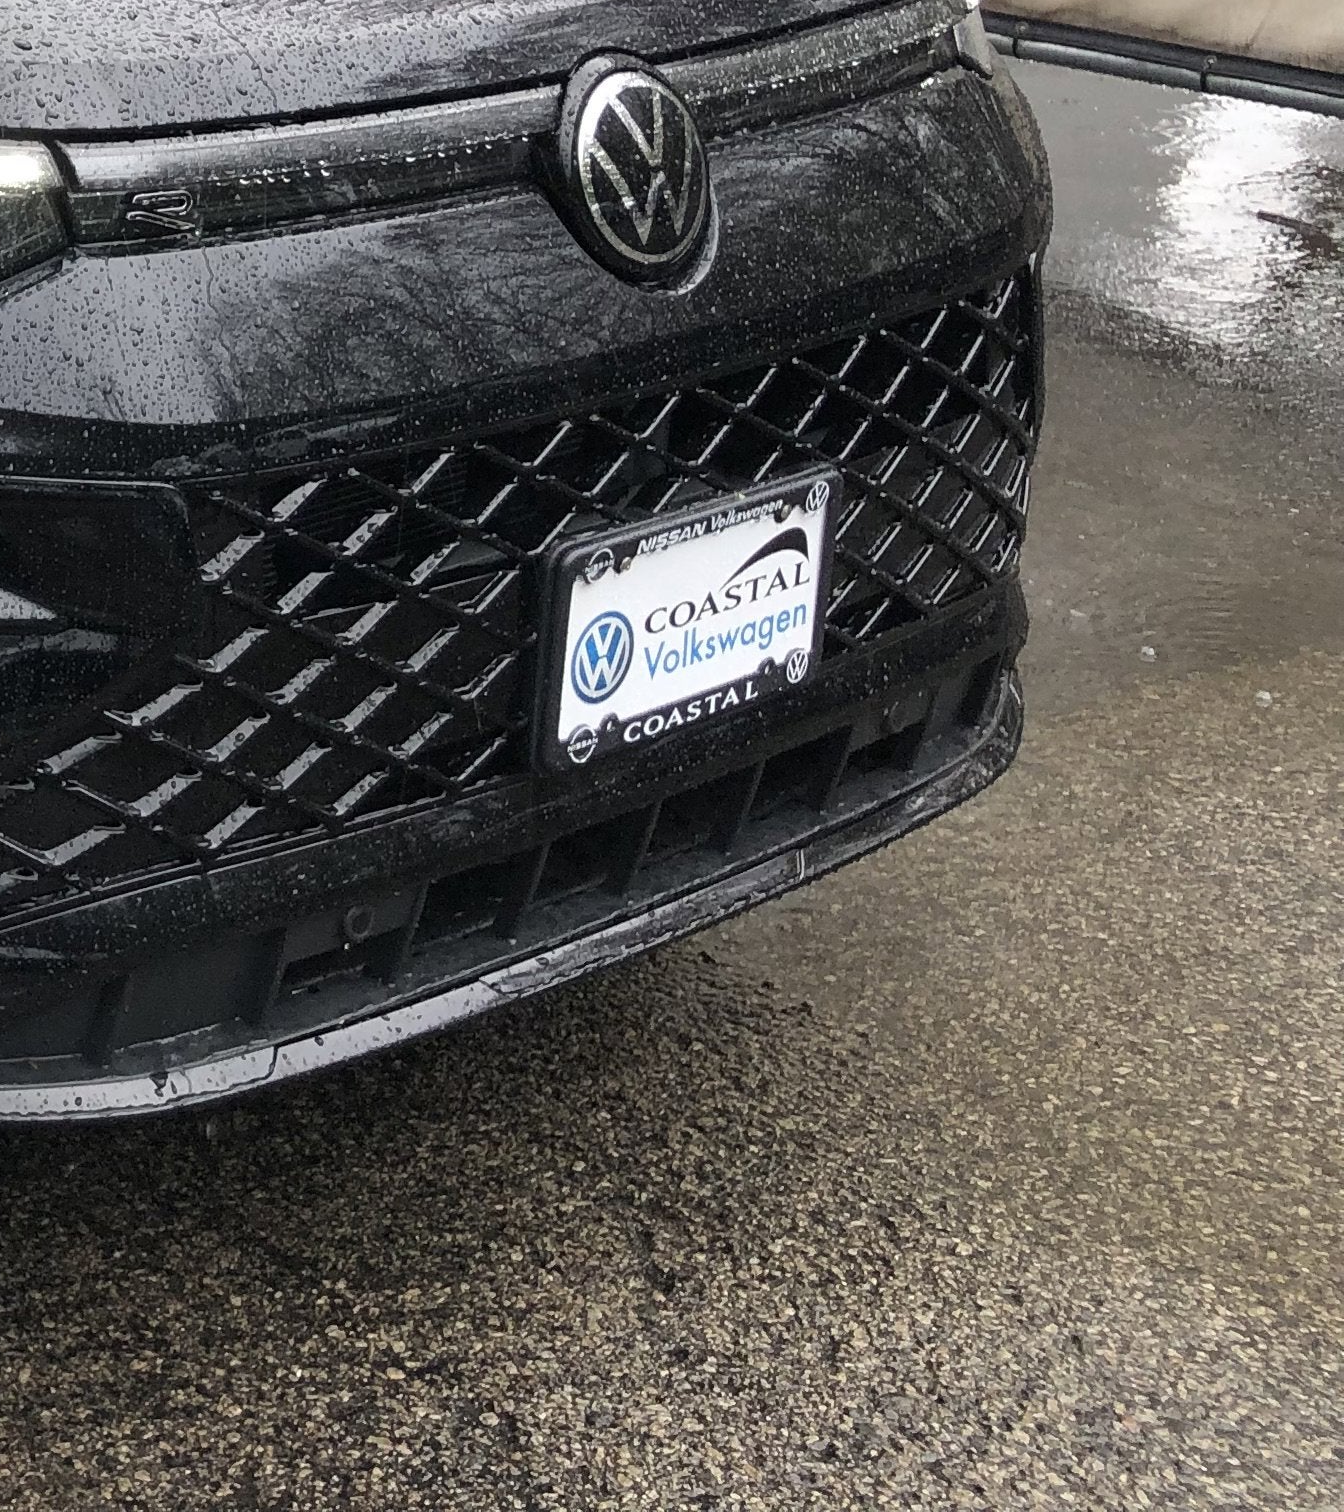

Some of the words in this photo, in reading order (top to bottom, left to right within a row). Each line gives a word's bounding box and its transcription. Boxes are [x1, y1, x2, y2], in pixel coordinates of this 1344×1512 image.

[577, 70, 708, 263] VW
[636, 520, 707, 554] NISSAN
[710, 498, 783, 530] Volkswagen
[644, 562, 810, 634] COASTAL
[570, 610, 634, 704] VW
[643, 603, 807, 680] Volkswagen
[786, 649, 809, 684] VW
[623, 681, 759, 742] COASTAL
